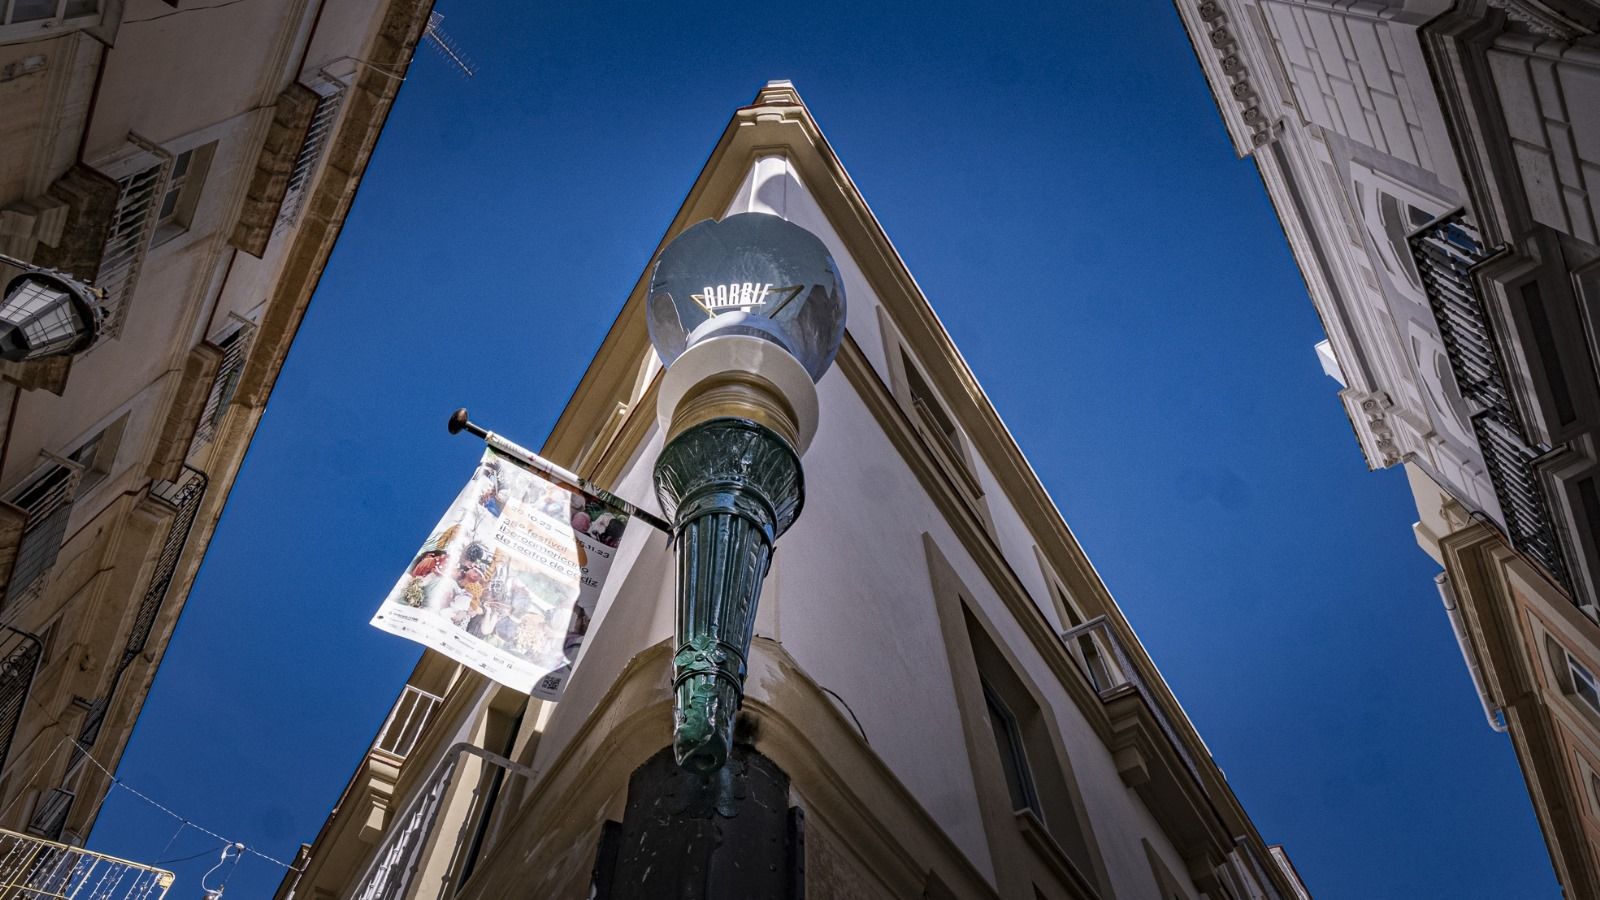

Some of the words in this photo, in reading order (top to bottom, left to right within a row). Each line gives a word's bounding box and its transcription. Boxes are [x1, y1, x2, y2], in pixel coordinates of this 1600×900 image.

[510, 505, 552, 531] 2010.23
[495, 533, 512, 545] de
[513, 541, 548, 564] teatro
[549, 559, 565, 571] de
[527, 528, 570, 553] festival
